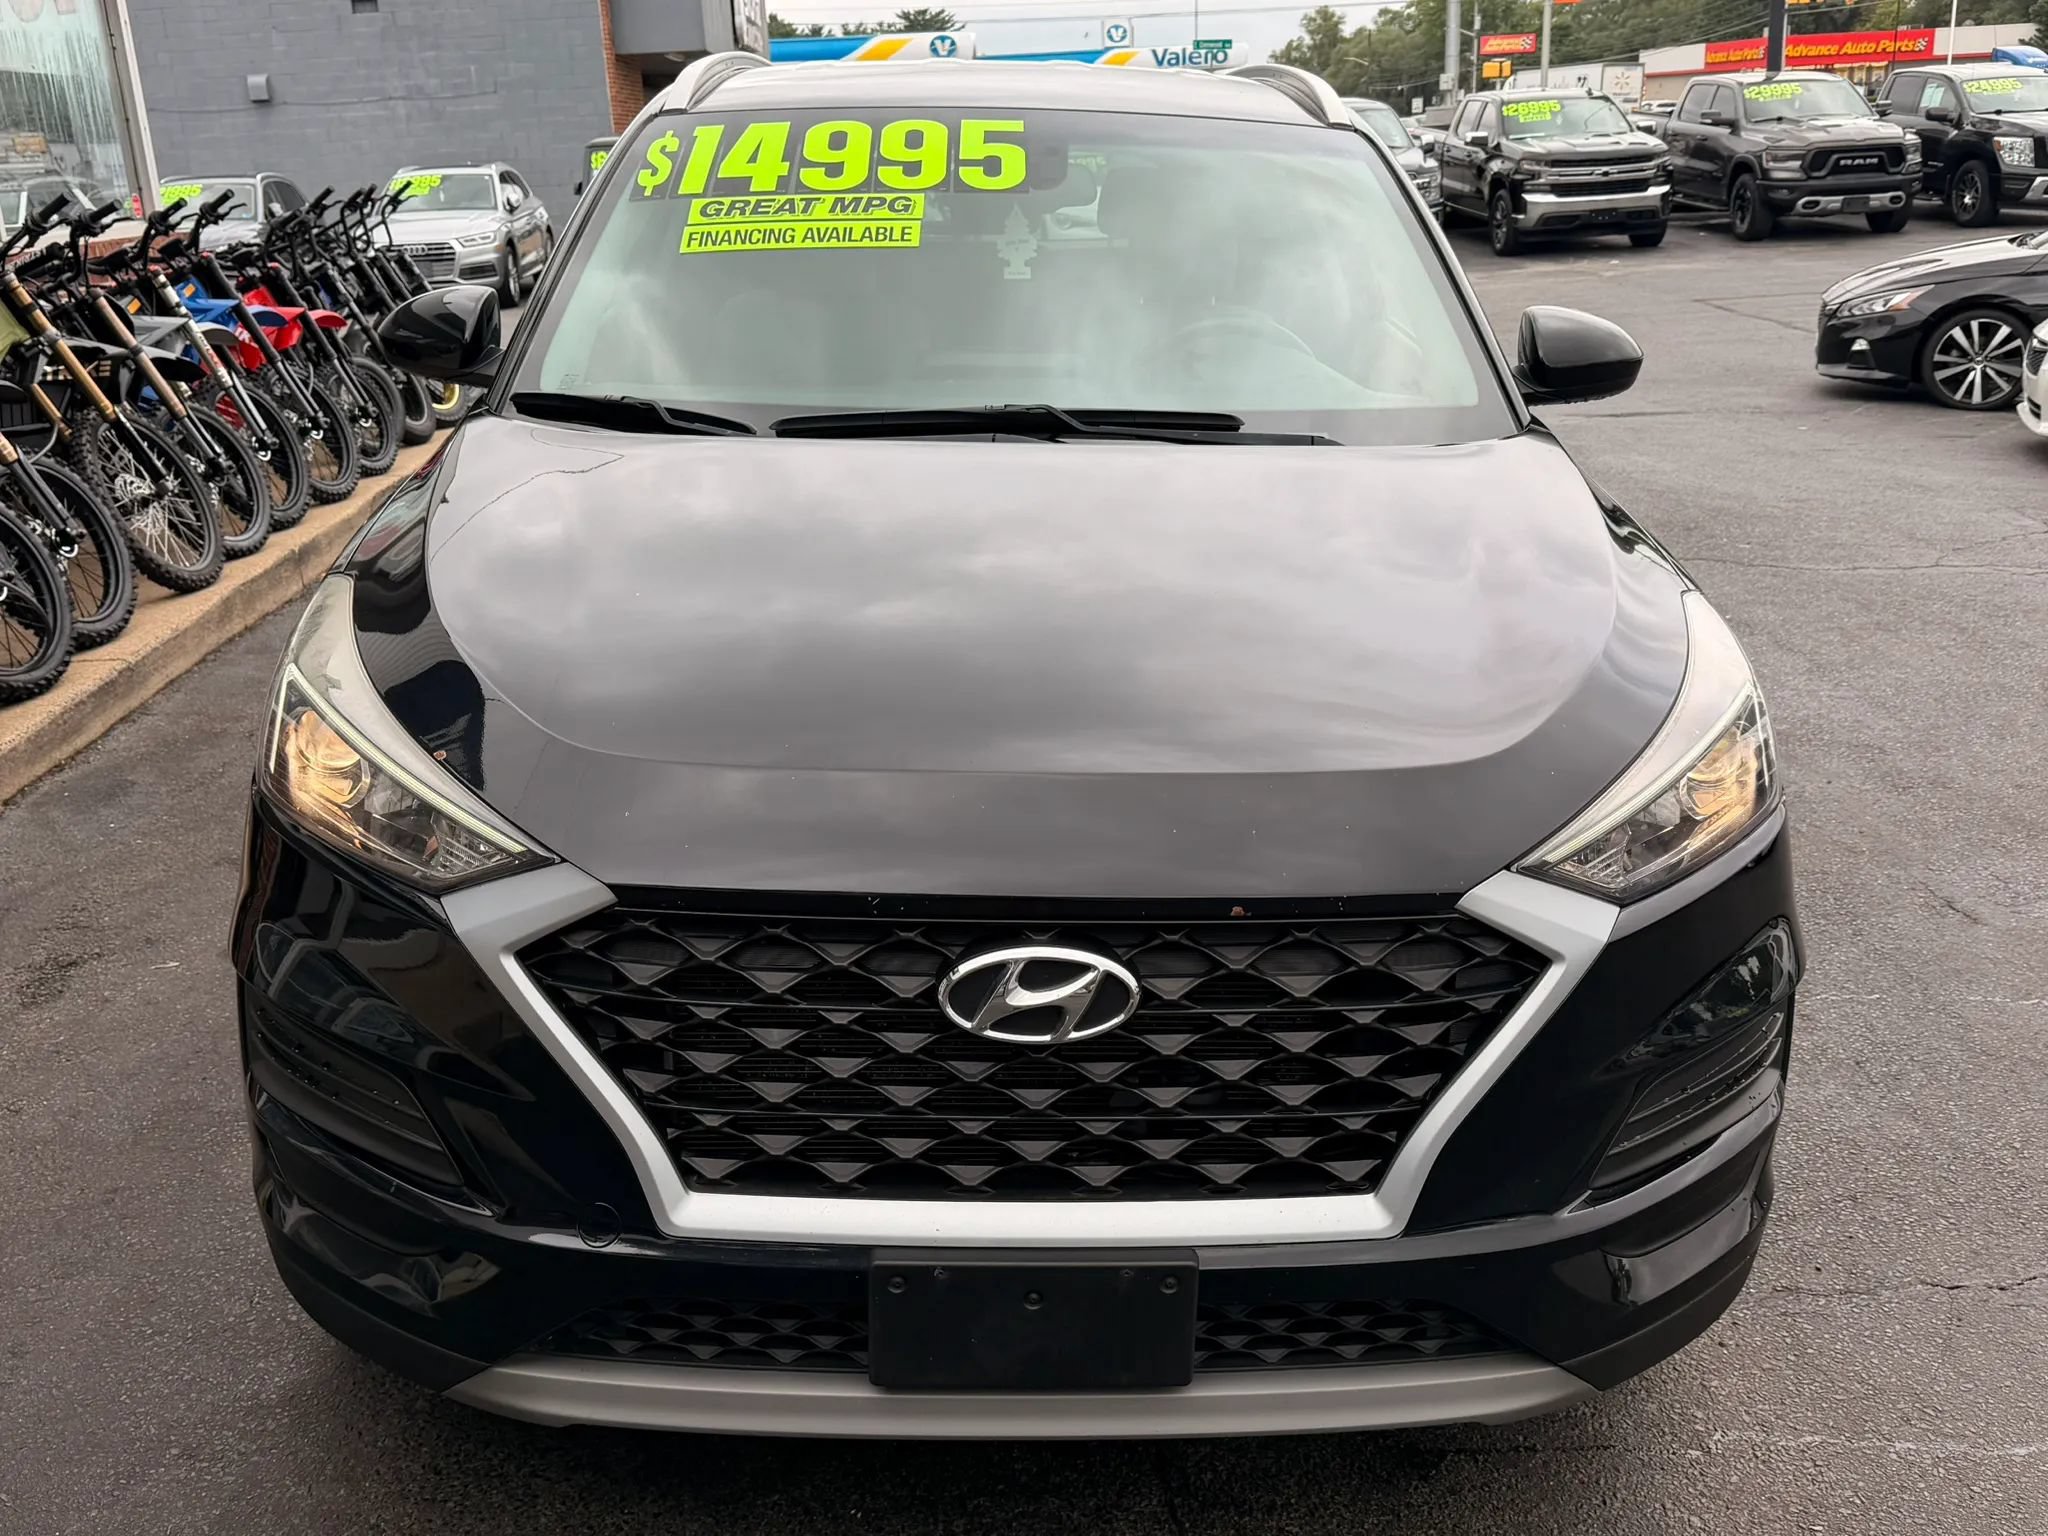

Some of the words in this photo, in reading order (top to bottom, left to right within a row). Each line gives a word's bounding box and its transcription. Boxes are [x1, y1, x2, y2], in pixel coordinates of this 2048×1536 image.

[1152, 48, 1228, 66] Valero
[1785, 43, 1839, 58] Advance
[1840, 41, 1876, 55] Auto
[1877, 39, 1915, 53] Parts
[1743, 82, 1802, 99] $29995
[1963, 78, 2023, 93] $24995
[1502, 100, 1561, 117] $26995
[637, 119, 1026, 196] $14995
[1840, 158, 1878, 166] RAM
[699, 198, 824, 219] GREAT
[828, 195, 916, 217] MPG
[686, 229, 795, 248] FINANCING
[801, 226, 912, 245] AVAILABLE
